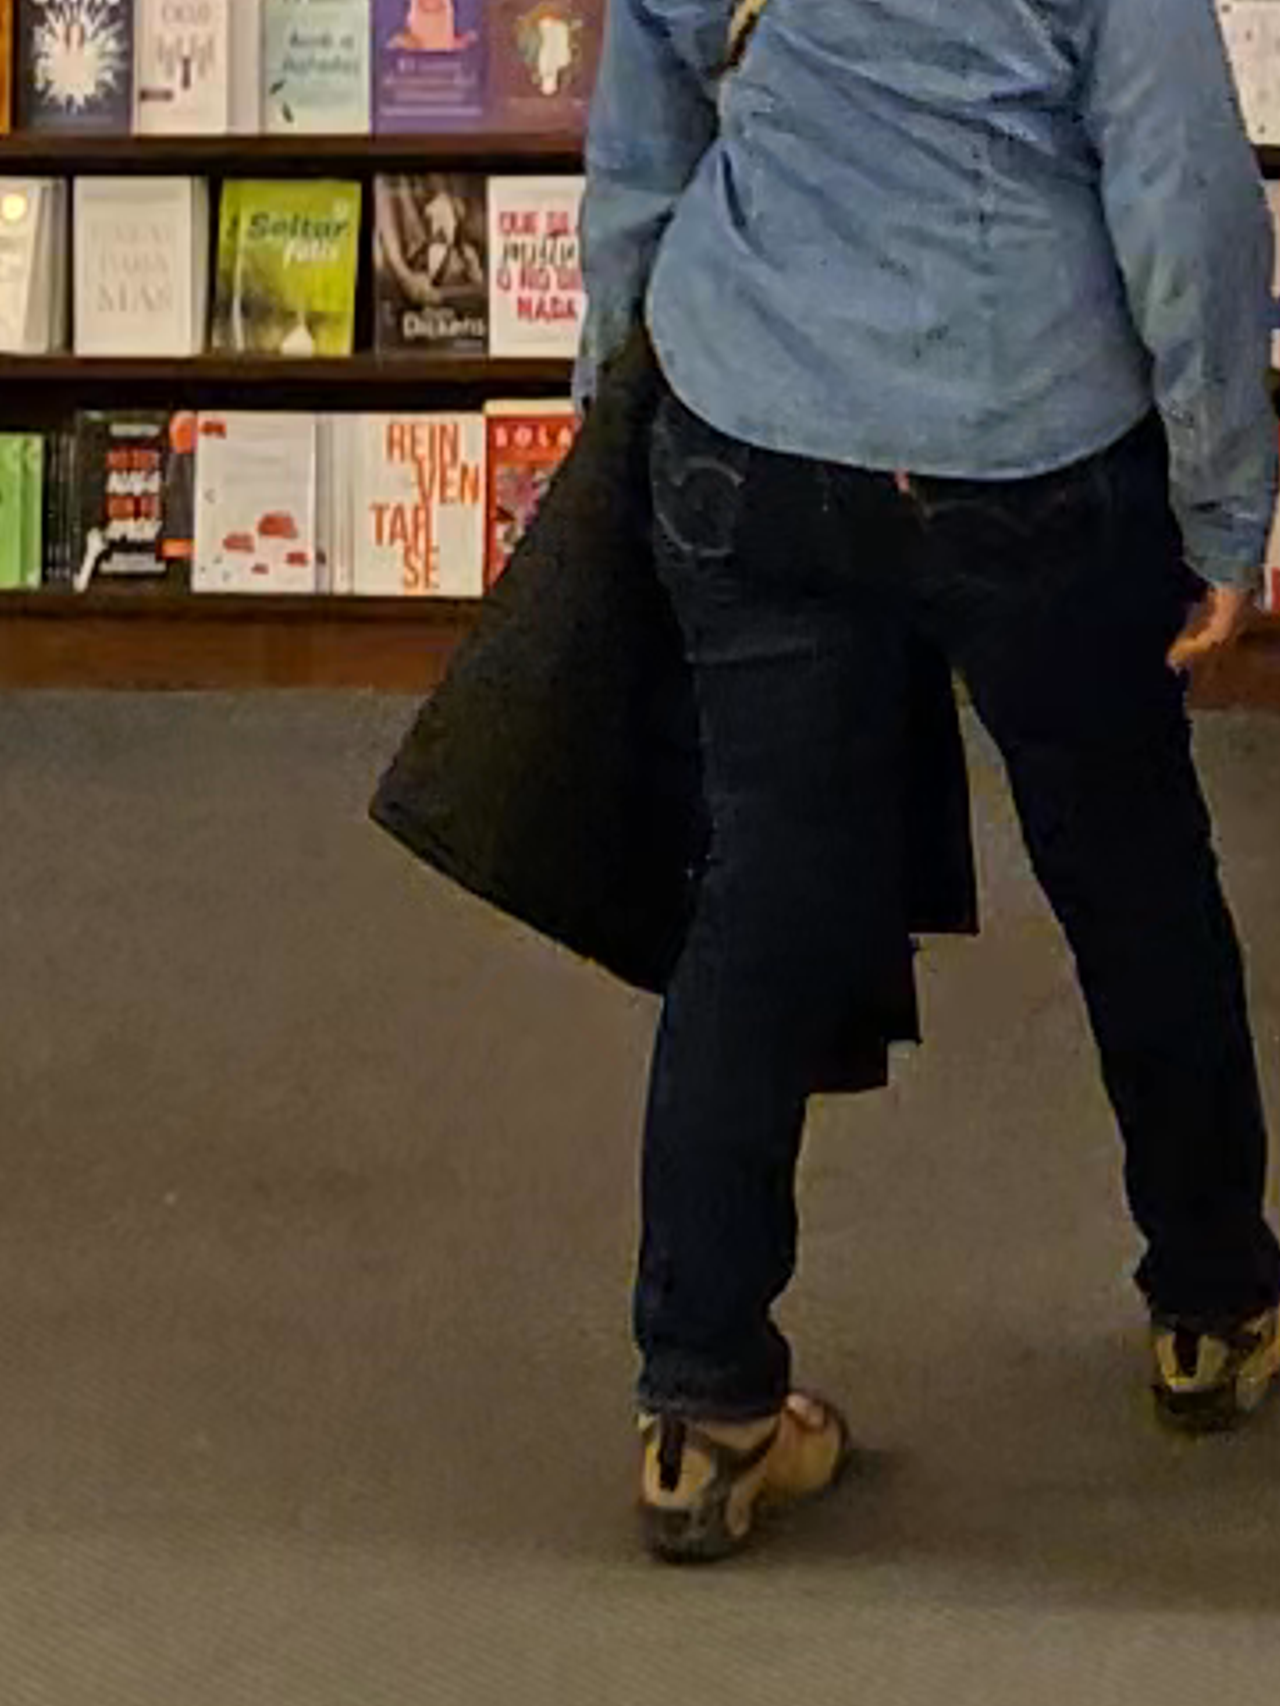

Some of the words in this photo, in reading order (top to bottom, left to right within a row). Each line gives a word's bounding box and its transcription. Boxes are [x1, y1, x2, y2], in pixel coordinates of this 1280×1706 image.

[403, 311, 486, 340] Dickens
[517, 297, 577, 322] NADA
[387, 422, 460, 464] REIN
[417, 462, 480, 505] VEN
[370, 501, 432, 548] TAR
[403, 544, 440, 589] SE
